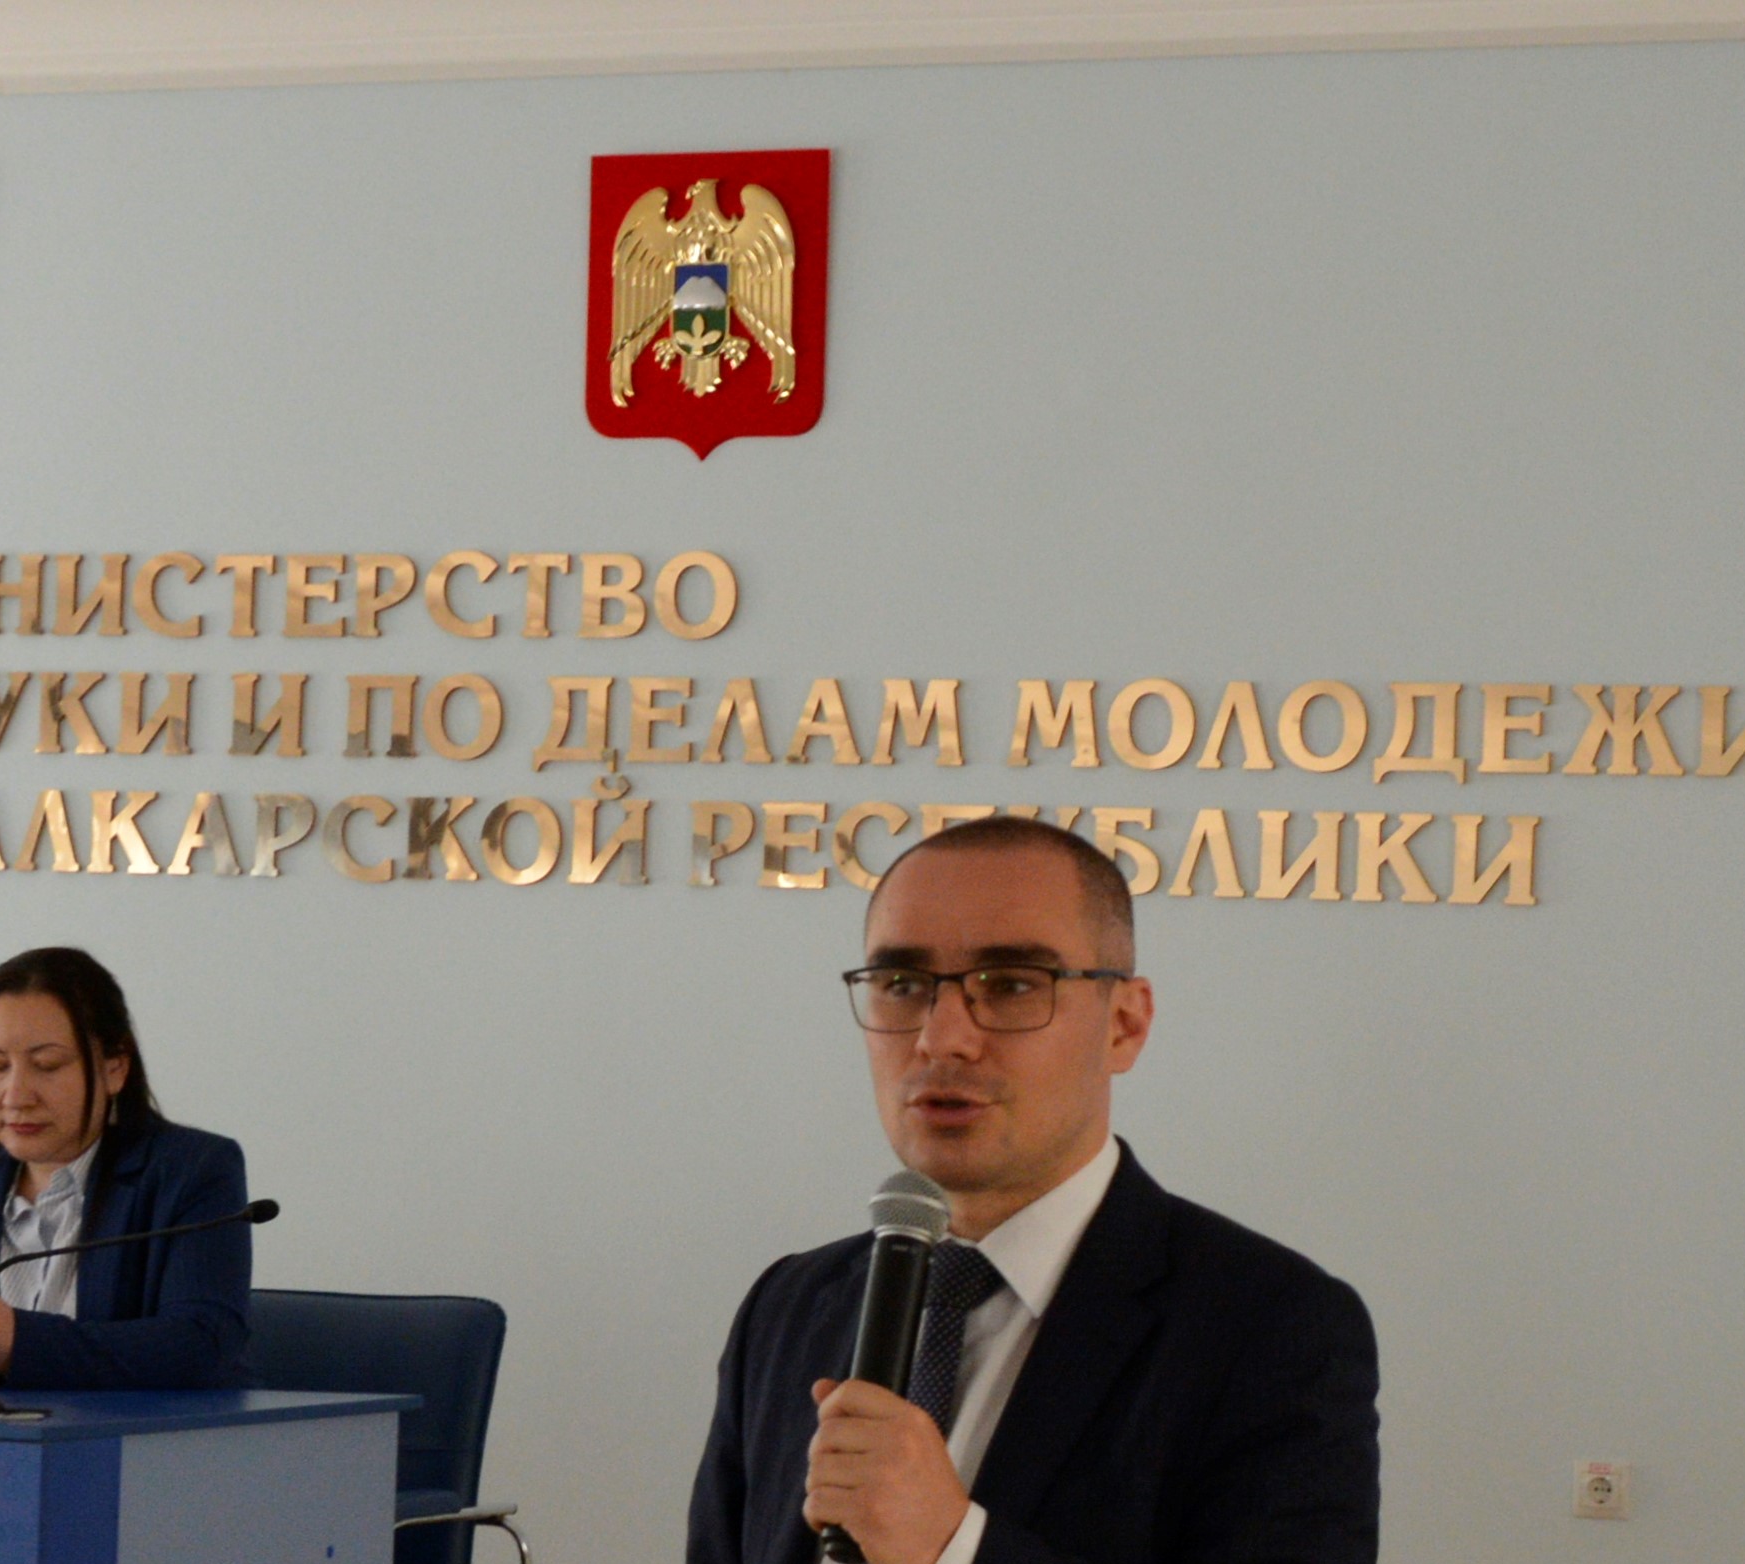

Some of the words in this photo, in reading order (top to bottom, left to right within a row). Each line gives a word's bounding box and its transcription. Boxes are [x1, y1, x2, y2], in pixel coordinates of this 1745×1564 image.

[227, 672, 304, 757] И
[343, 672, 505, 760] ПО
[529, 674, 961, 772] ДЕЛАМ
[689, 801, 1541, 905] РЕСБЛИКИ
